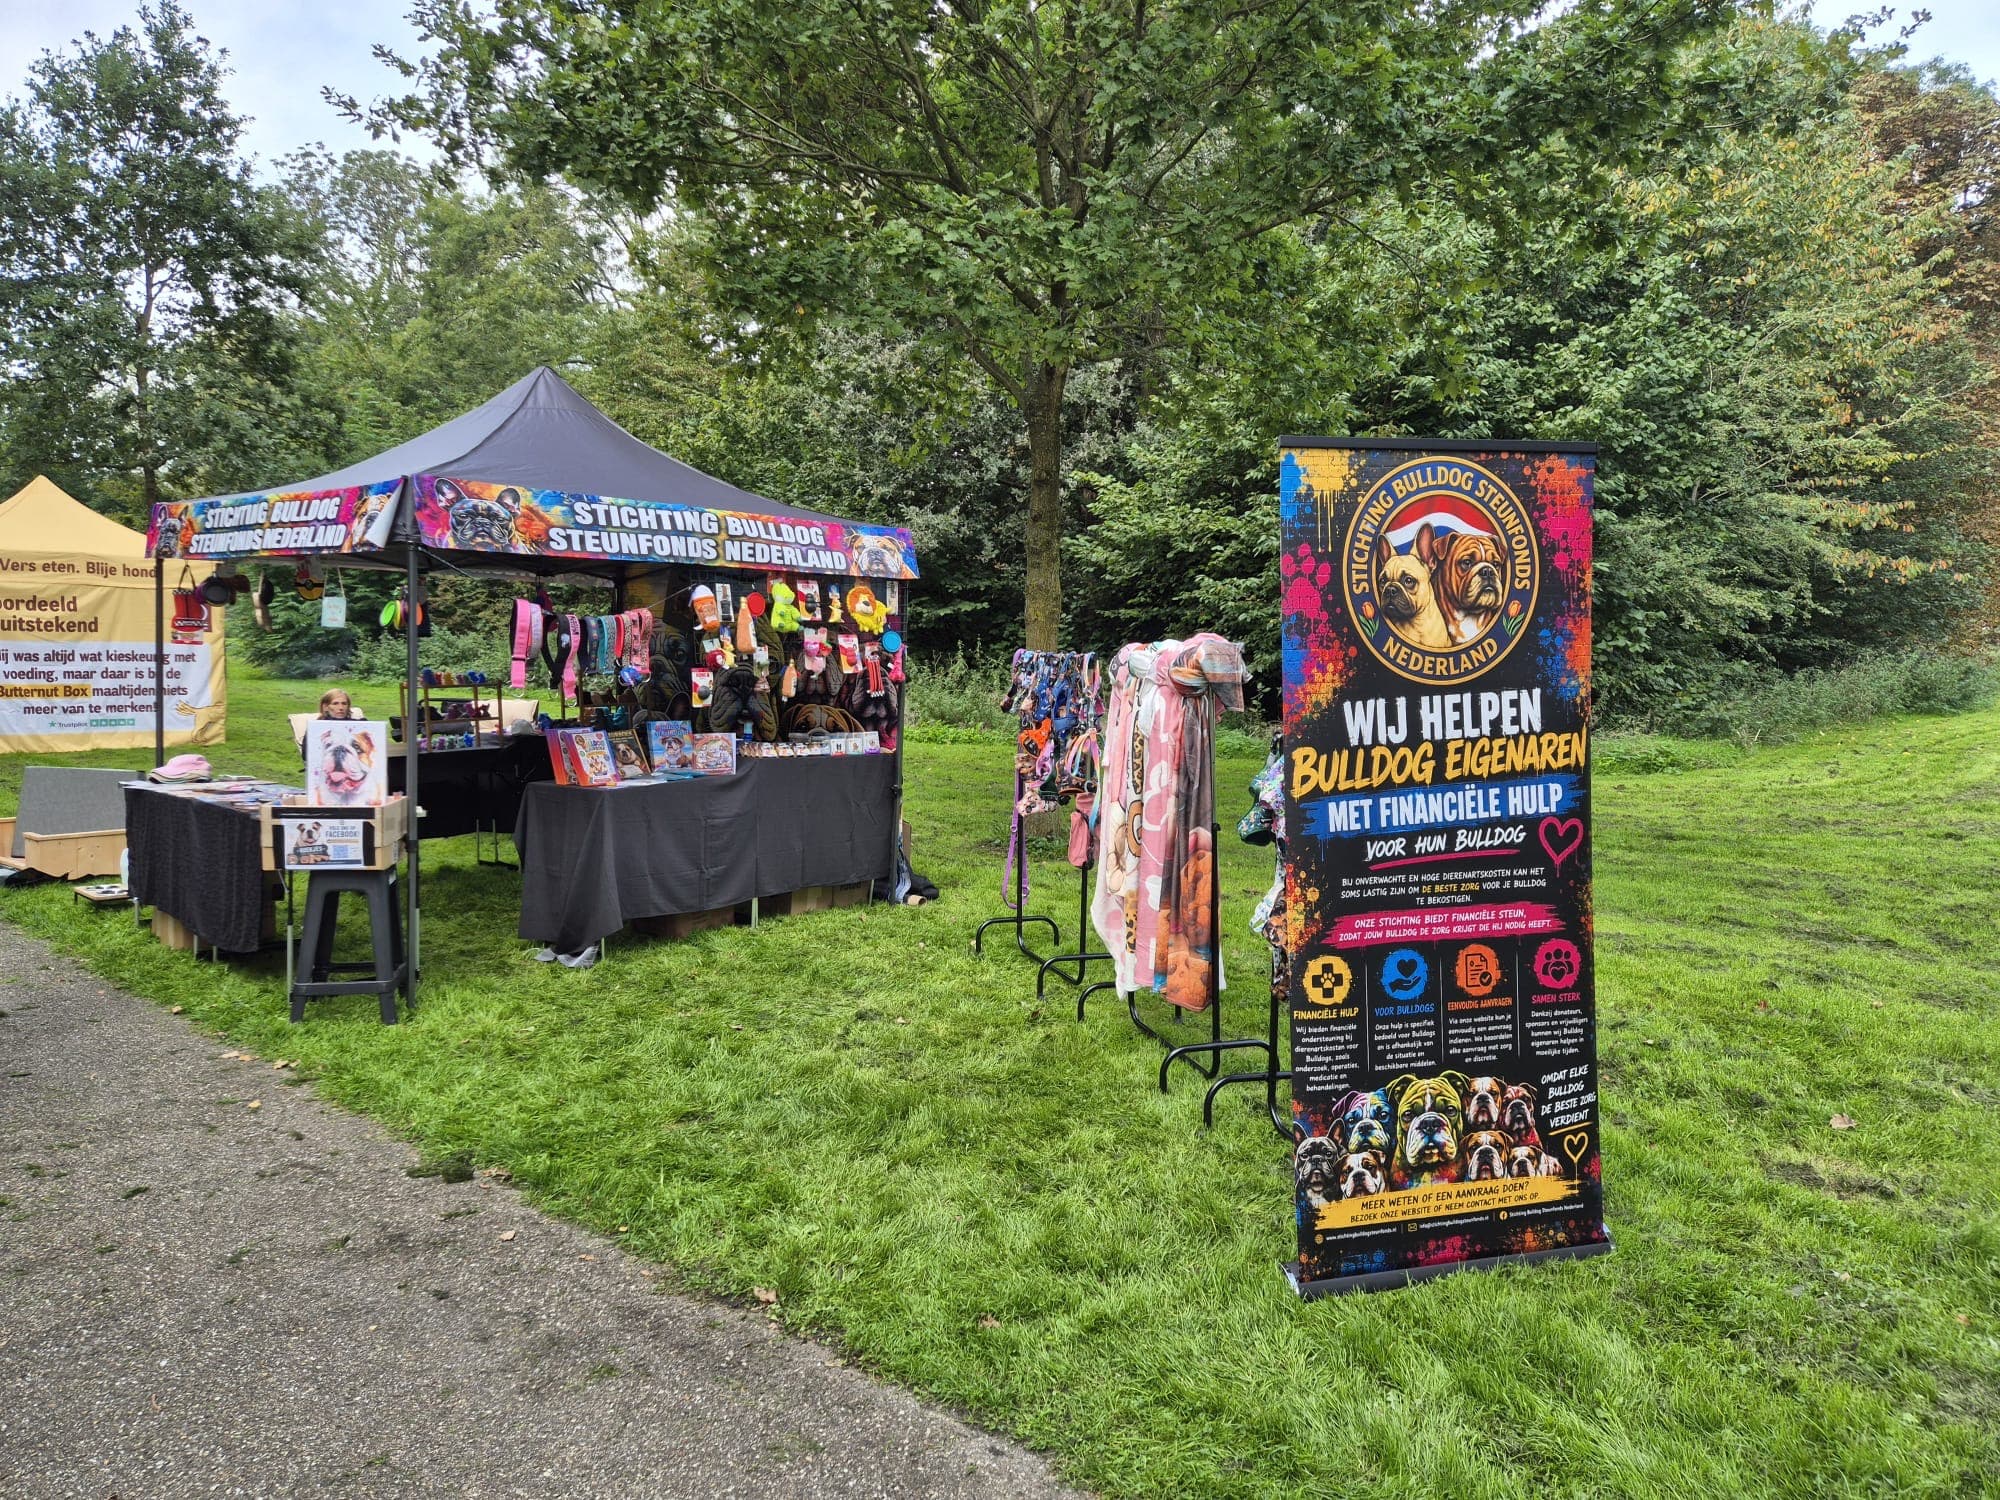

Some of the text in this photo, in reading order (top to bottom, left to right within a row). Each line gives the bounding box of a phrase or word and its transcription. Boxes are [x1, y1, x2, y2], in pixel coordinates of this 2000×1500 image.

[270, 497, 340, 522] BULLDOG
[574, 502, 824, 546] STICHTING BULLDOG
[1352, 466, 1531, 595] STICHTING BULLDOG STEUNFONDS
[262, 524, 347, 549] NEDERLAND
[548, 528, 847, 570] STEUNFONDS NEDERLAND
[0, 558, 36, 572] Vers
[42, 561, 80, 574] eten.
[86, 562, 117, 578] Blije
[1, 616, 98, 632] uitstekend
[14, 652, 40, 662] was
[43, 650, 75, 664] altijd
[80, 652, 101, 662] wat
[174, 652, 196, 662] met
[1383, 636, 1498, 676] NEDERLAND
[3, 668, 58, 682] voeding,
[63, 670, 96, 679] maar
[101, 668, 130, 679] daar
[135, 668, 144, 679] is
[166, 668, 181, 679] de
[0, 686, 59, 698] Butternut
[64, 686, 88, 697] Box
[92, 684, 156, 699] maaltijden
[24, 704, 57, 715] meer
[62, 704, 84, 714] van
[88, 703, 101, 714] te
[1343, 688, 1542, 746] WIJ HELPEN
[1290, 726, 1587, 799] BULLDOG EIGENAREN
[1328, 782, 1563, 832] MET FINANCIËLE HULP
[1364, 824, 1527, 862] VOOR HUN BULLDOG
[1342, 878, 1353, 886] BIJ
[1356, 874, 1406, 886] ONVERWACHTE
[1422, 873, 1440, 881] HOGE
[1442, 869, 1511, 880] DIERENARTSKOSTEN
[1513, 868, 1528, 876] KAN
[1341, 890, 1360, 899] SOMS
[1362, 888, 1387, 897] LASTIG
[1390, 887, 1406, 895] ZIJN
[1408, 886, 1419, 894] OM
[1434, 884, 1457, 892] BESTE
[1482, 881, 1500, 890] VOOR
[1502, 880, 1511, 888] JE
[1514, 879, 1546, 888] BULLDOG
[1416, 894, 1472, 905] TE BEKOSTIGEN.
[1355, 909, 1526, 928] ONZE STICHTING BIEDT FINANCIËLE STEUN,
[1339, 932, 1361, 941] ZODAT
[1364, 931, 1382, 939] JOUW
[1386, 928, 1417, 938] BULLDOG
[1432, 926, 1450, 934] ZORG
[1453, 924, 1477, 932] KRIJGT
[1492, 923, 1502, 931] HIJ
[1505, 921, 1526, 929] NODIG
[1528, 920, 1552, 928] HEEFT.
[1448, 1000, 1479, 1011] EENVOUDIG
[1532, 992, 1581, 1004] SAMEN STERK
[1294, 1007, 1359, 1020] FINANCIËLE HULP
[1375, 1003, 1435, 1016] VOOR BULLDOGS
[1541, 1064, 1589, 1084] OMDAT ELKE
[1548, 1080, 1584, 1099] BULLDOG
[1541, 1092, 1597, 1116] DE BESTE ZORG
[1550, 1109, 1589, 1128] VERDIENT
[1361, 1181, 1529, 1210] MEER WETEN OF EEN AANVRAAG DOEN?
[1350, 1212, 1378, 1222] BEZOEK
[1380, 1210, 1398, 1219] ONZE
[1402, 1206, 1430, 1216] WEBSITE
[1445, 1202, 1464, 1211] NEEM
[1466, 1198, 1496, 1208] CONTACT
[1499, 1196, 1512, 1204] MET
[1514, 1193, 1527, 1202] ONS
[1530, 1192, 1540, 1200] OP.
